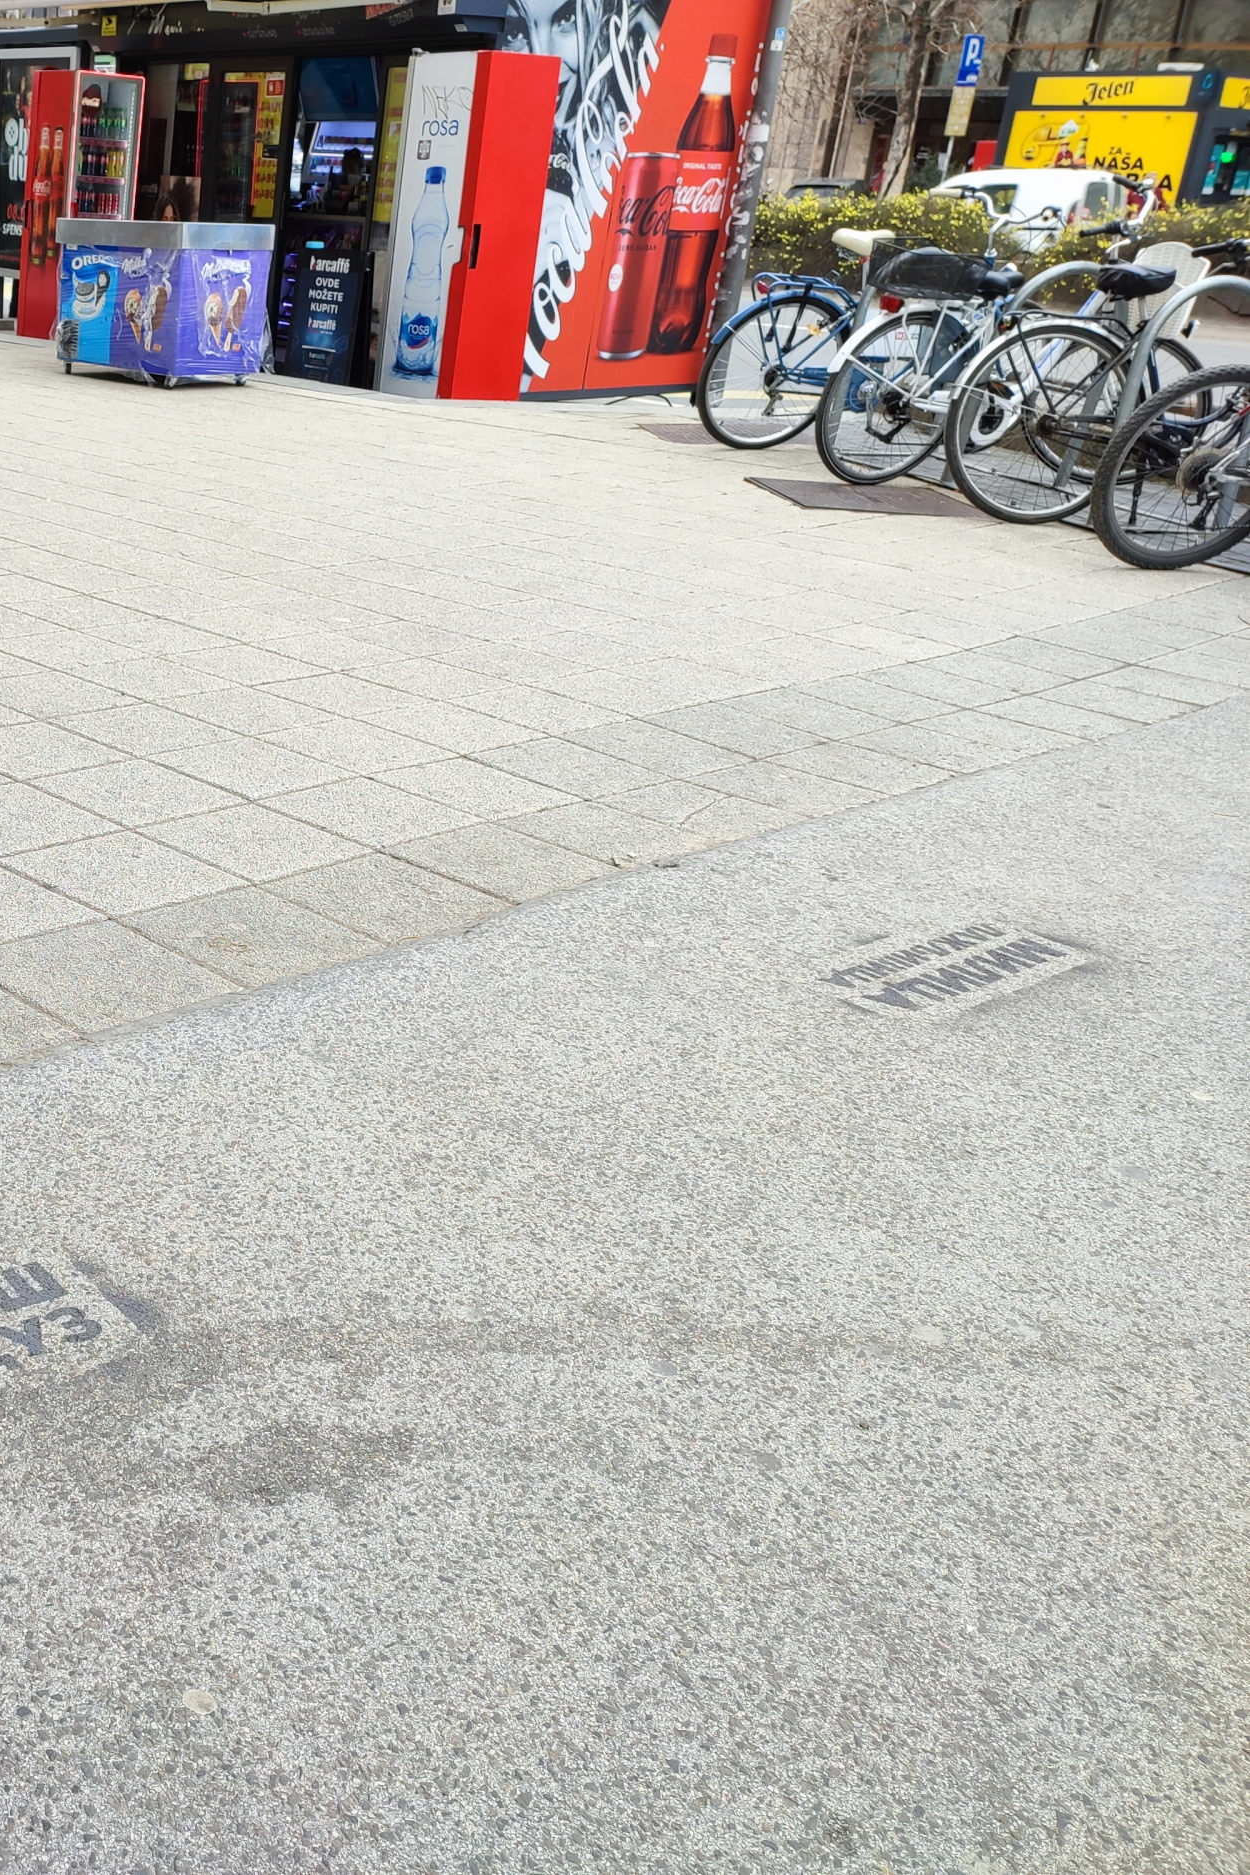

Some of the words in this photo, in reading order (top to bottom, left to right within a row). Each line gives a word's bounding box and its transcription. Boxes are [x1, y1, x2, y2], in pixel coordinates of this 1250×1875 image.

[966, 38, 980, 67] P
[1082, 79, 1135, 105] Jelen
[422, 119, 459, 136] rosa
[1093, 152, 1143, 170] NAŠA
[315, 277, 340, 288] OVDE
[308, 288, 344, 302] MOŽETE
[310, 302, 338, 314] KUPITI
[407, 323, 430, 335] rosa
[861, 937, 1069, 1011] МИЛИЦА
